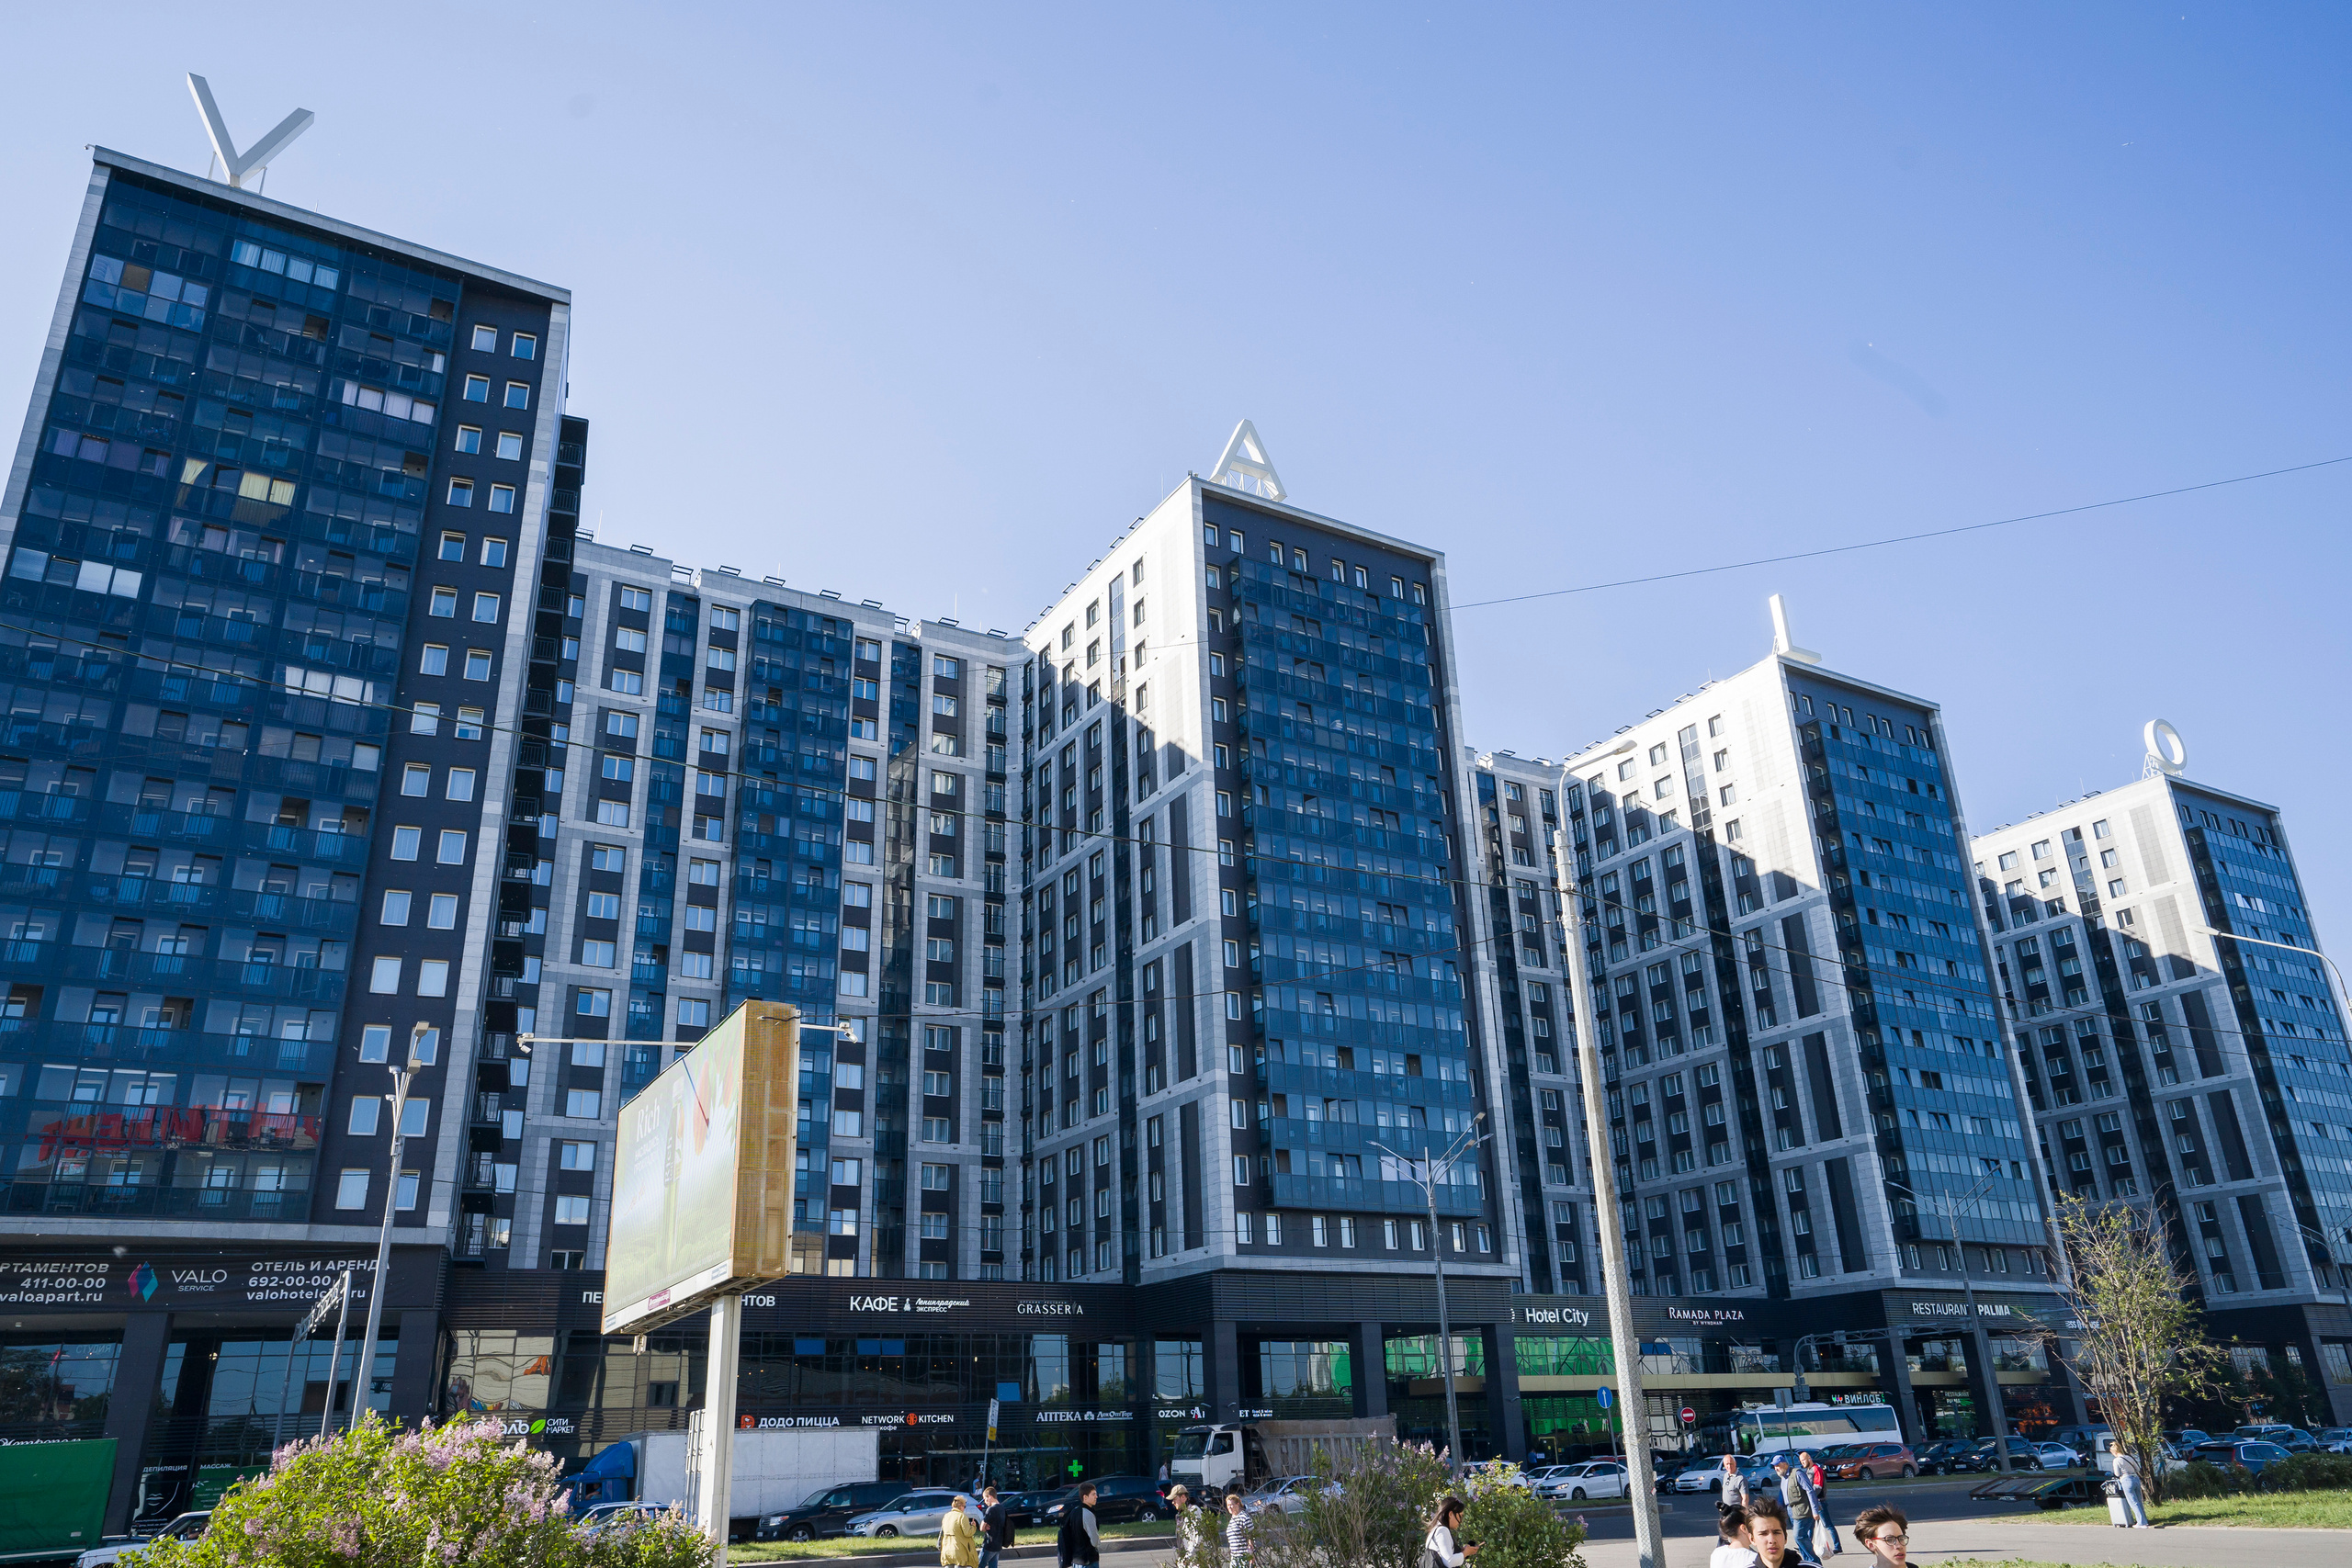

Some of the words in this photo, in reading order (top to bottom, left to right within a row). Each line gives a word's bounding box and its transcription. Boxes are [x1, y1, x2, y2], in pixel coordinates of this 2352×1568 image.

[187, 72, 315, 186] V
[1208, 419, 1288, 502] A
[2143, 718, 2187, 773] O
[636, 1098, 660, 1142] Rich
[251, 1261, 305, 1272] ОТЕЛЬ
[310, 1260, 322, 1271] И
[325, 1259, 390, 1271] АРЕНД
[171, 1269, 228, 1283] VALO
[248, 1275, 331, 1287] 692-00-00
[20, 1278, 107, 1289] 411-00-00
[0, 1291, 103, 1304] valoapart.ru
[850, 1296, 899, 1312] КАФЕ
[1525, 1307, 1560, 1323] Hotel
[1563, 1308, 1589, 1326] City
[1668, 1306, 1711, 1319] RAMADA
[1714, 1310, 1745, 1320] PLAZA
[1977, 1304, 2010, 1316] PALMA
[862, 1416, 905, 1424] NETWORK
[919, 1415, 954, 1423] KITCHEN
[1036, 1411, 1081, 1422] АПТЕКА
[1159, 1409, 1185, 1418] OZON
[758, 1417, 794, 1428] ДОДО
[797, 1416, 840, 1427] ПИЦЦА
[142, 1465, 188, 1473] ДЕПИЛЯЦИЯ
